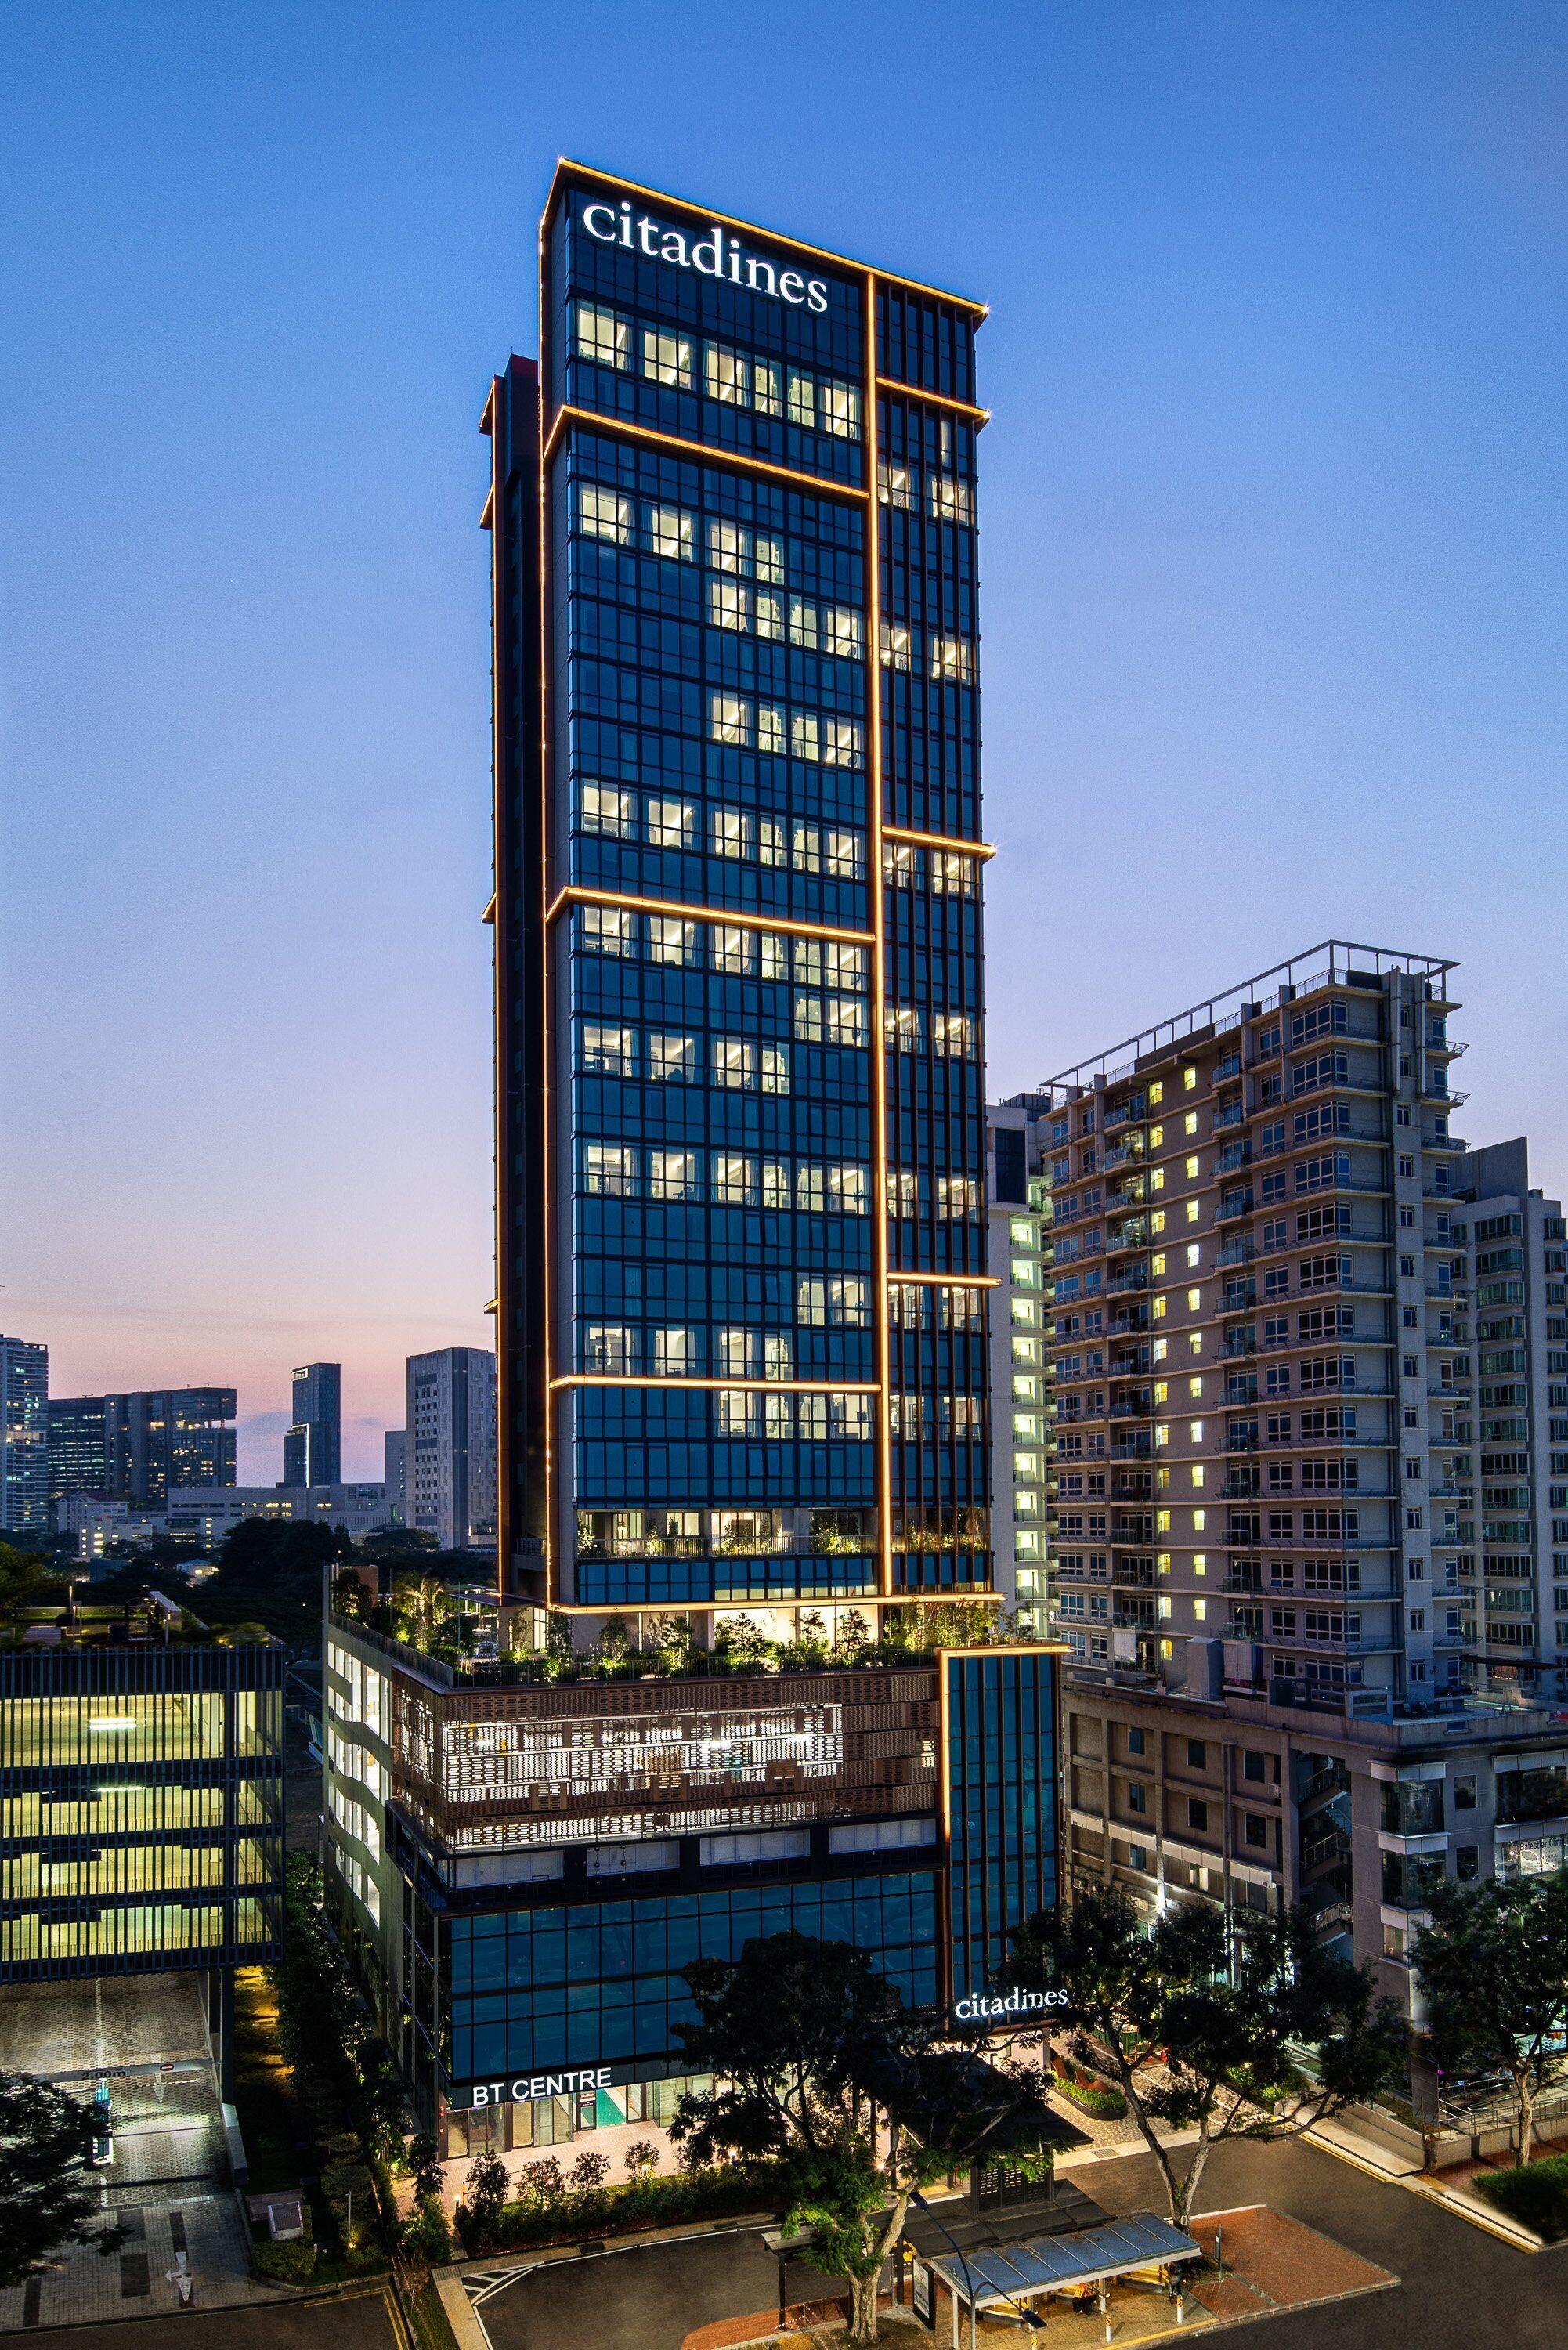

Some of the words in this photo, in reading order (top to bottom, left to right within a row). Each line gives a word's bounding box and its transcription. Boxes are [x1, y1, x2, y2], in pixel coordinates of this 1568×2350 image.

[583, 202, 828, 313] citadines
[1520, 1839, 1547, 1850] Balester
[955, 1986, 1068, 2019] citadines
[81, 2071, 125, 2080] 2.00m
[472, 2082, 505, 2106] BT
[511, 2067, 612, 2100] CENTRE
